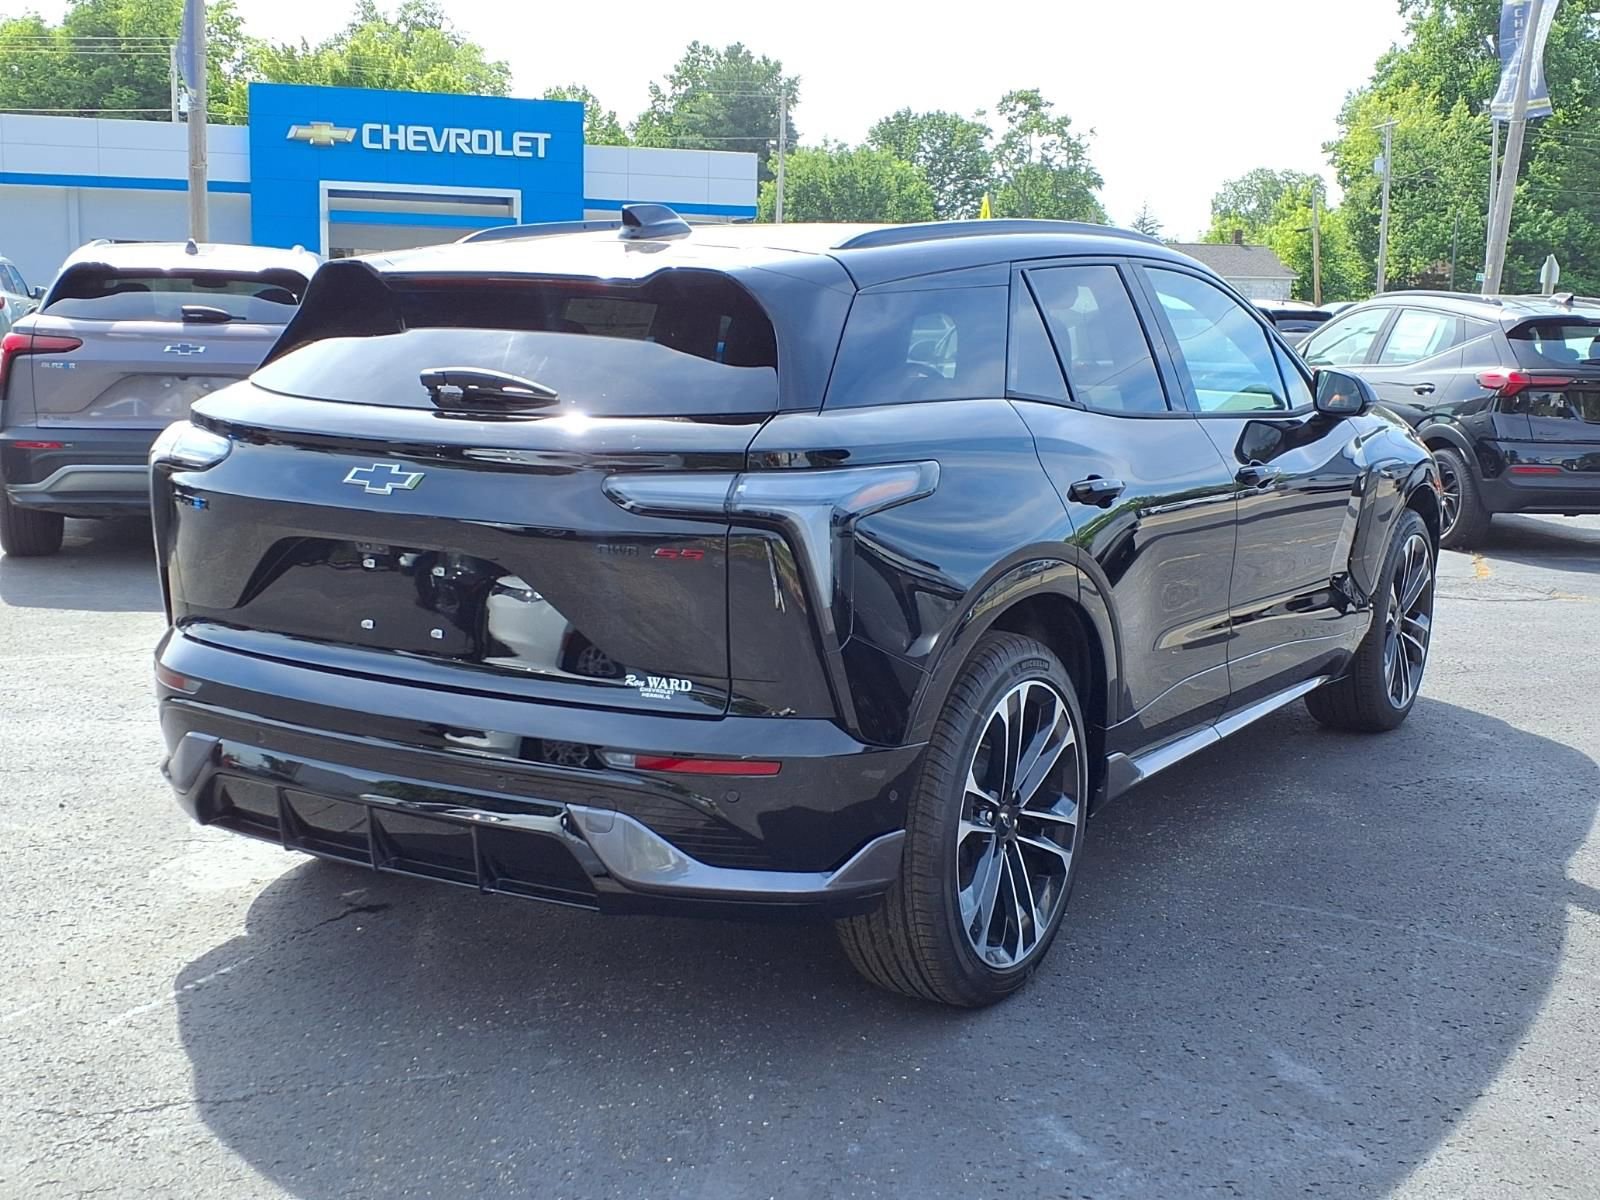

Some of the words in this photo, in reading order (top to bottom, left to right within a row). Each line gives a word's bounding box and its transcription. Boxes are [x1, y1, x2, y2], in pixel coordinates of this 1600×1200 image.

[361, 122, 552, 158] CHEVROLET
[652, 547, 705, 561] SS
[624, 674, 646, 687] Ron
[646, 675, 693, 692] WARD
[639, 687, 675, 696] CHEVROLET
